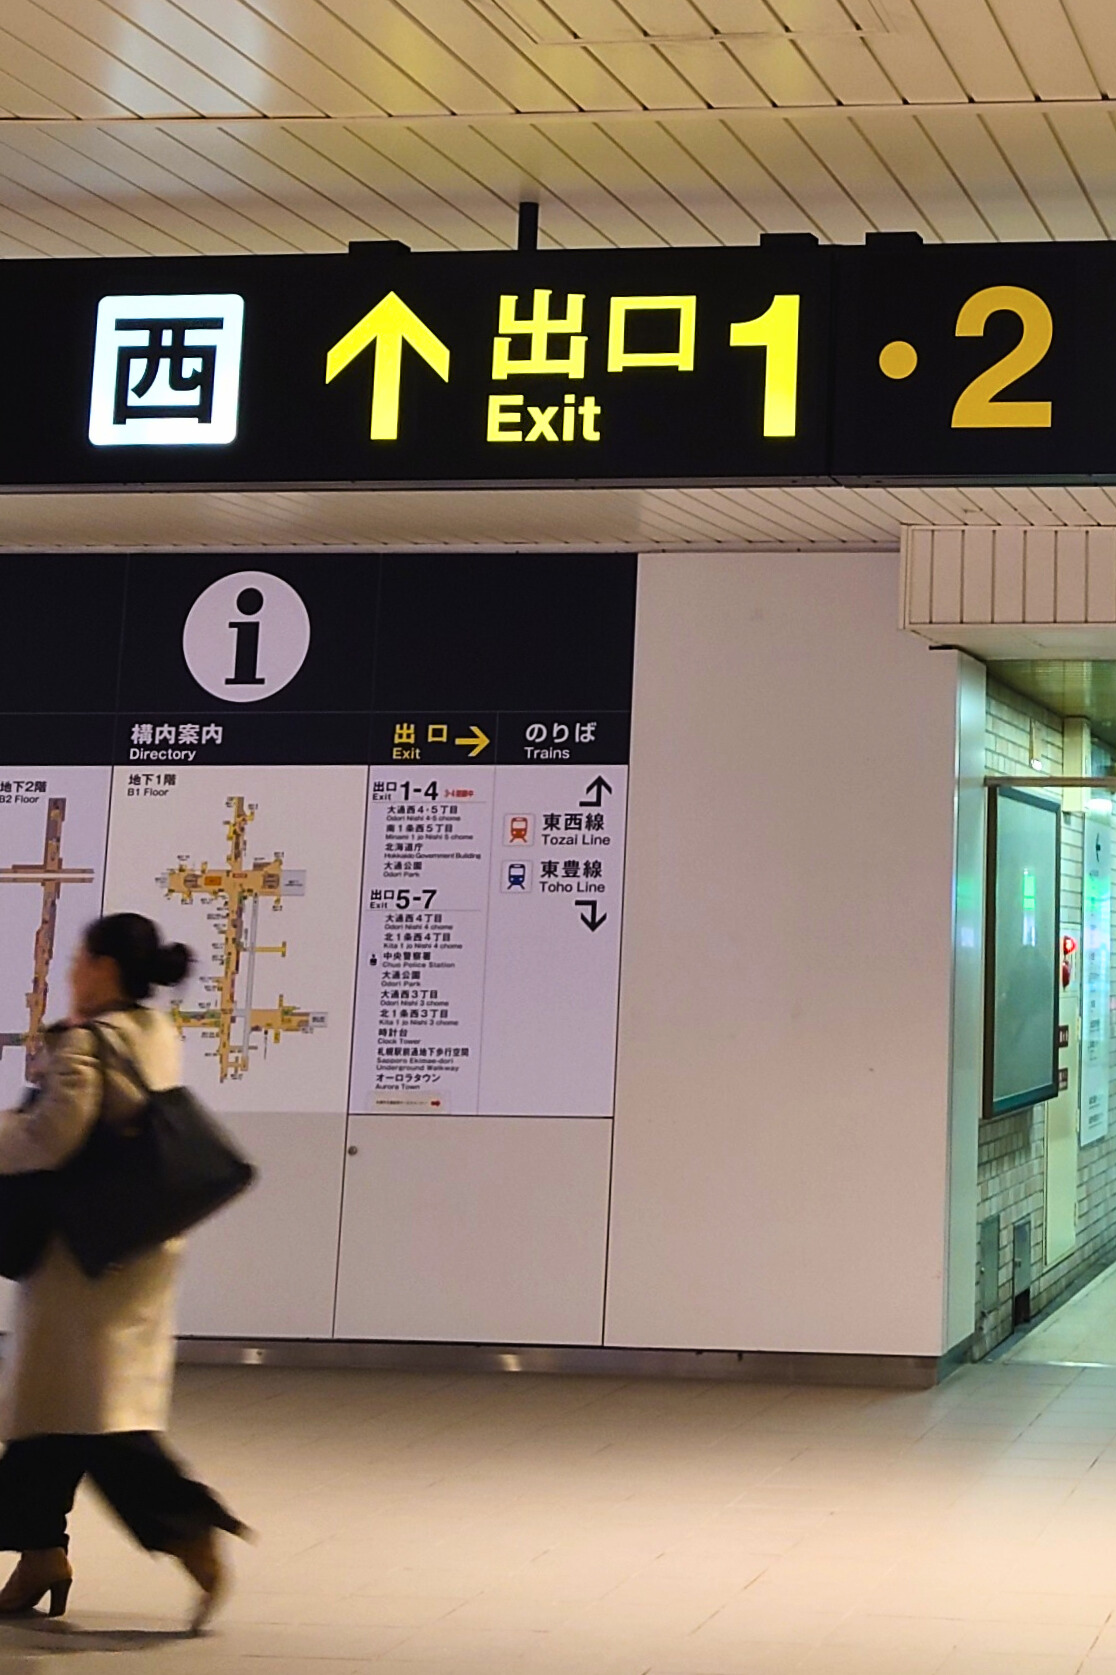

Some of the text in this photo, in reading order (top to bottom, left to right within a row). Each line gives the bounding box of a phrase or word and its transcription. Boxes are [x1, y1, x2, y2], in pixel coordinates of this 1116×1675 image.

[492, 288, 697, 380] 出口
[730, 294, 800, 437] 1
[113, 317, 224, 426] 西
[486, 394, 601, 442] Exit
[130, 723, 223, 745] 構内案内
[394, 723, 448, 743] 出口
[525, 722, 597, 743] のりば
[129, 748, 197, 761] Directory
[392, 747, 421, 759] Exit
[524, 747, 570, 759] Trains
[0, 781, 47, 793] 地下2階
[128, 774, 177, 787] 地下1階
[127, 788, 169, 796] B1 Floor
[372, 793, 392, 801] Exit
[373, 781, 397, 792] 出口
[400, 781, 438, 801] 1-4
[15, 795, 39, 803] Floor
[542, 812, 605, 831] 東西線
[542, 834, 611, 845] Tozai Line
[540, 860, 603, 878] 東豊線
[539, 881, 606, 893] Toho Line
[370, 889, 437, 909] 出口 5-7
